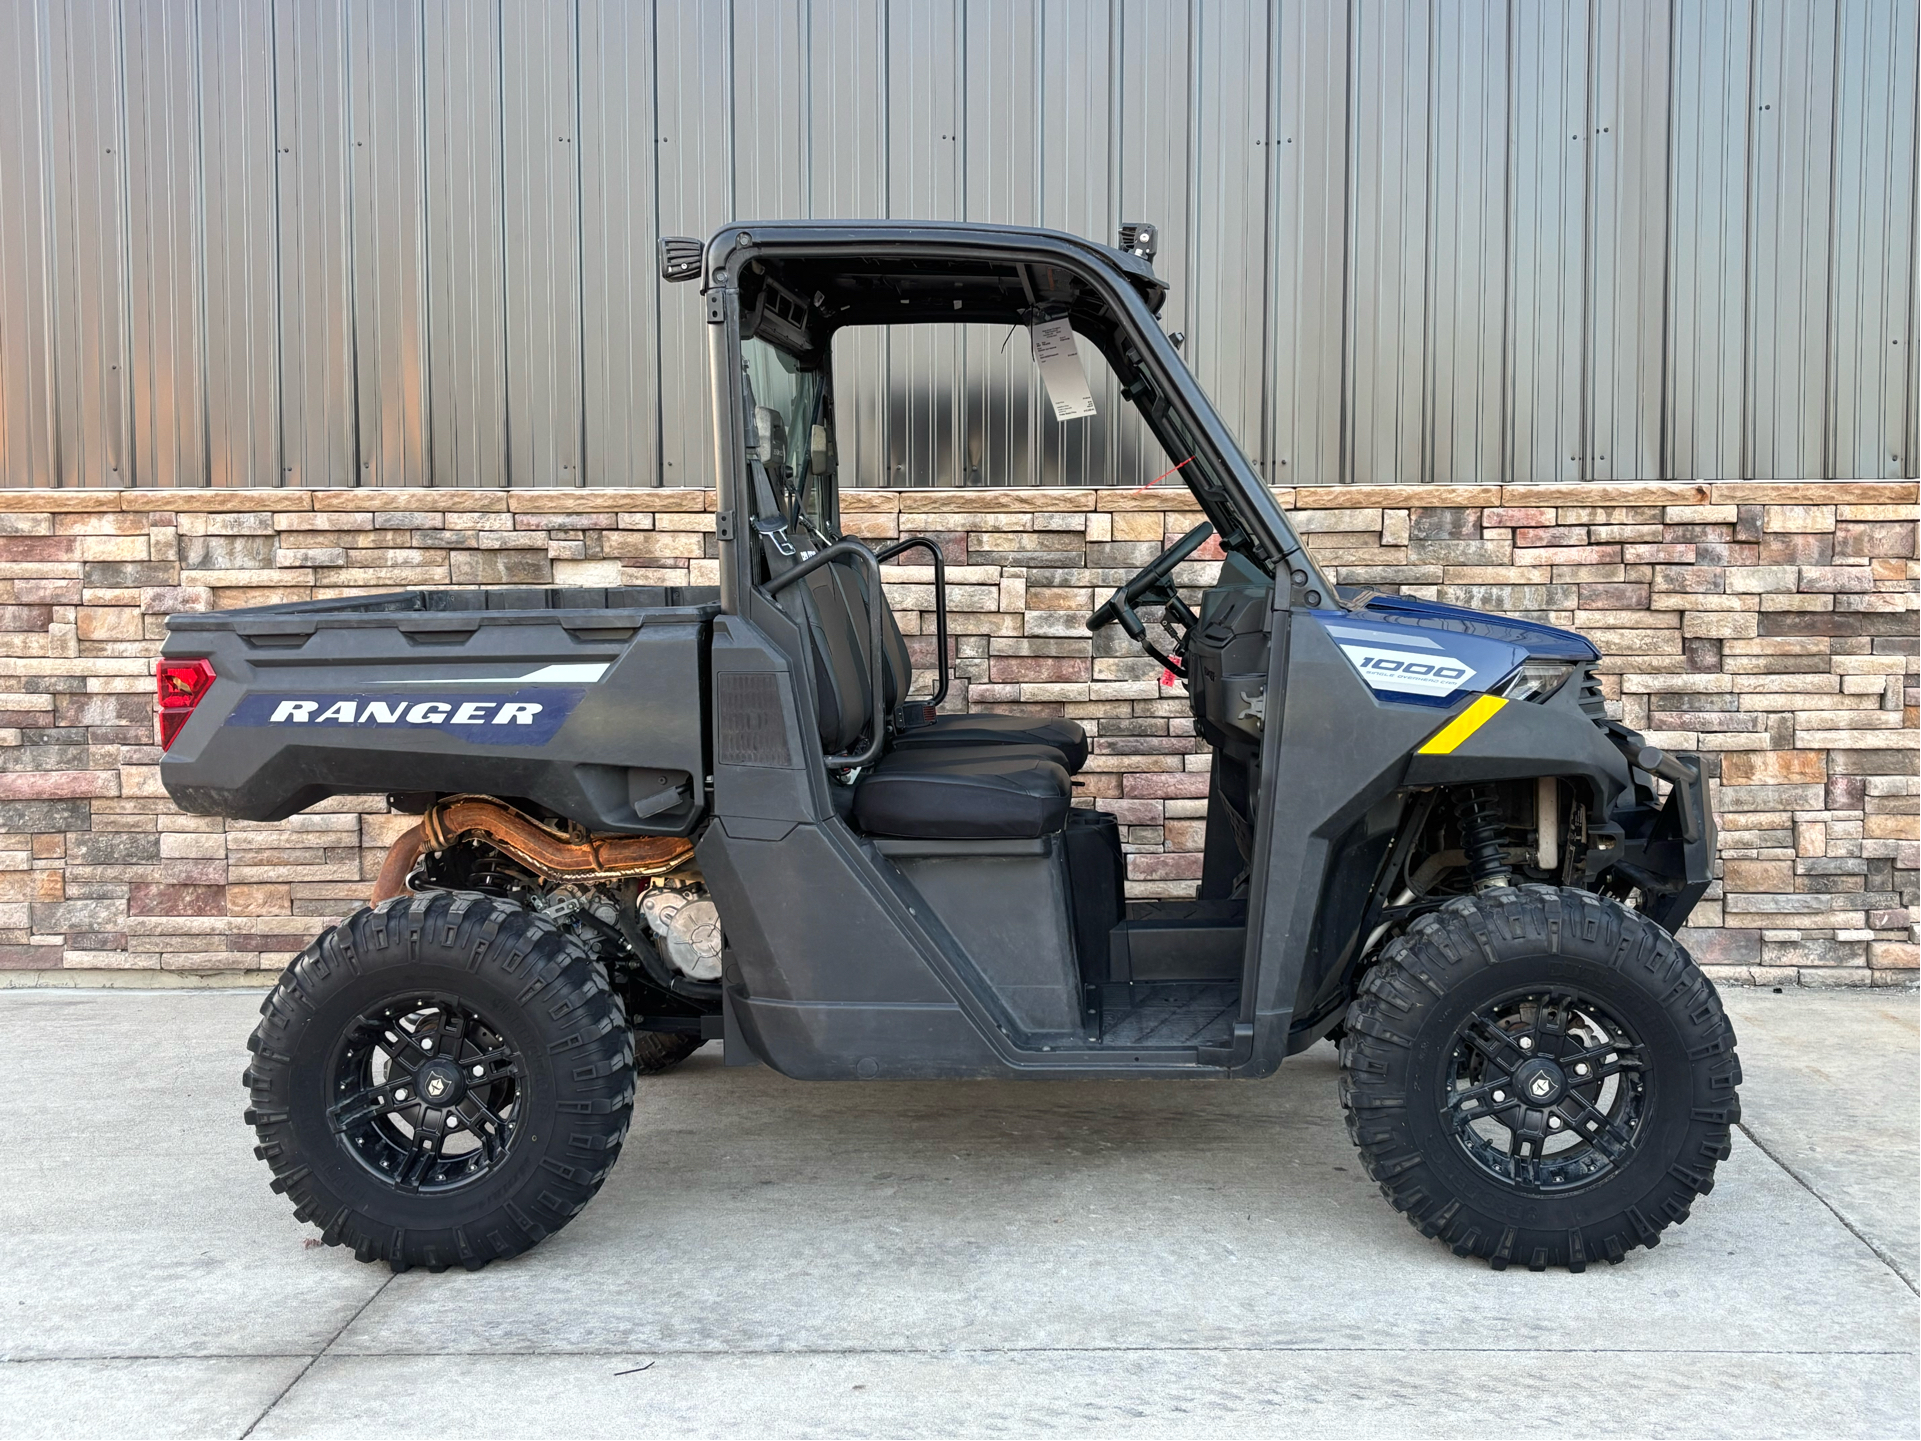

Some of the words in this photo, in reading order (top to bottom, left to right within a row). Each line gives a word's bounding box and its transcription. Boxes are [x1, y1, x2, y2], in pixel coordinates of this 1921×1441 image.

[1360, 657, 1466, 680] 1000
[1365, 670, 1395, 678] SINGLE
[1397, 674, 1439, 684] OVERHEAD
[269, 700, 543, 725] RANGER
